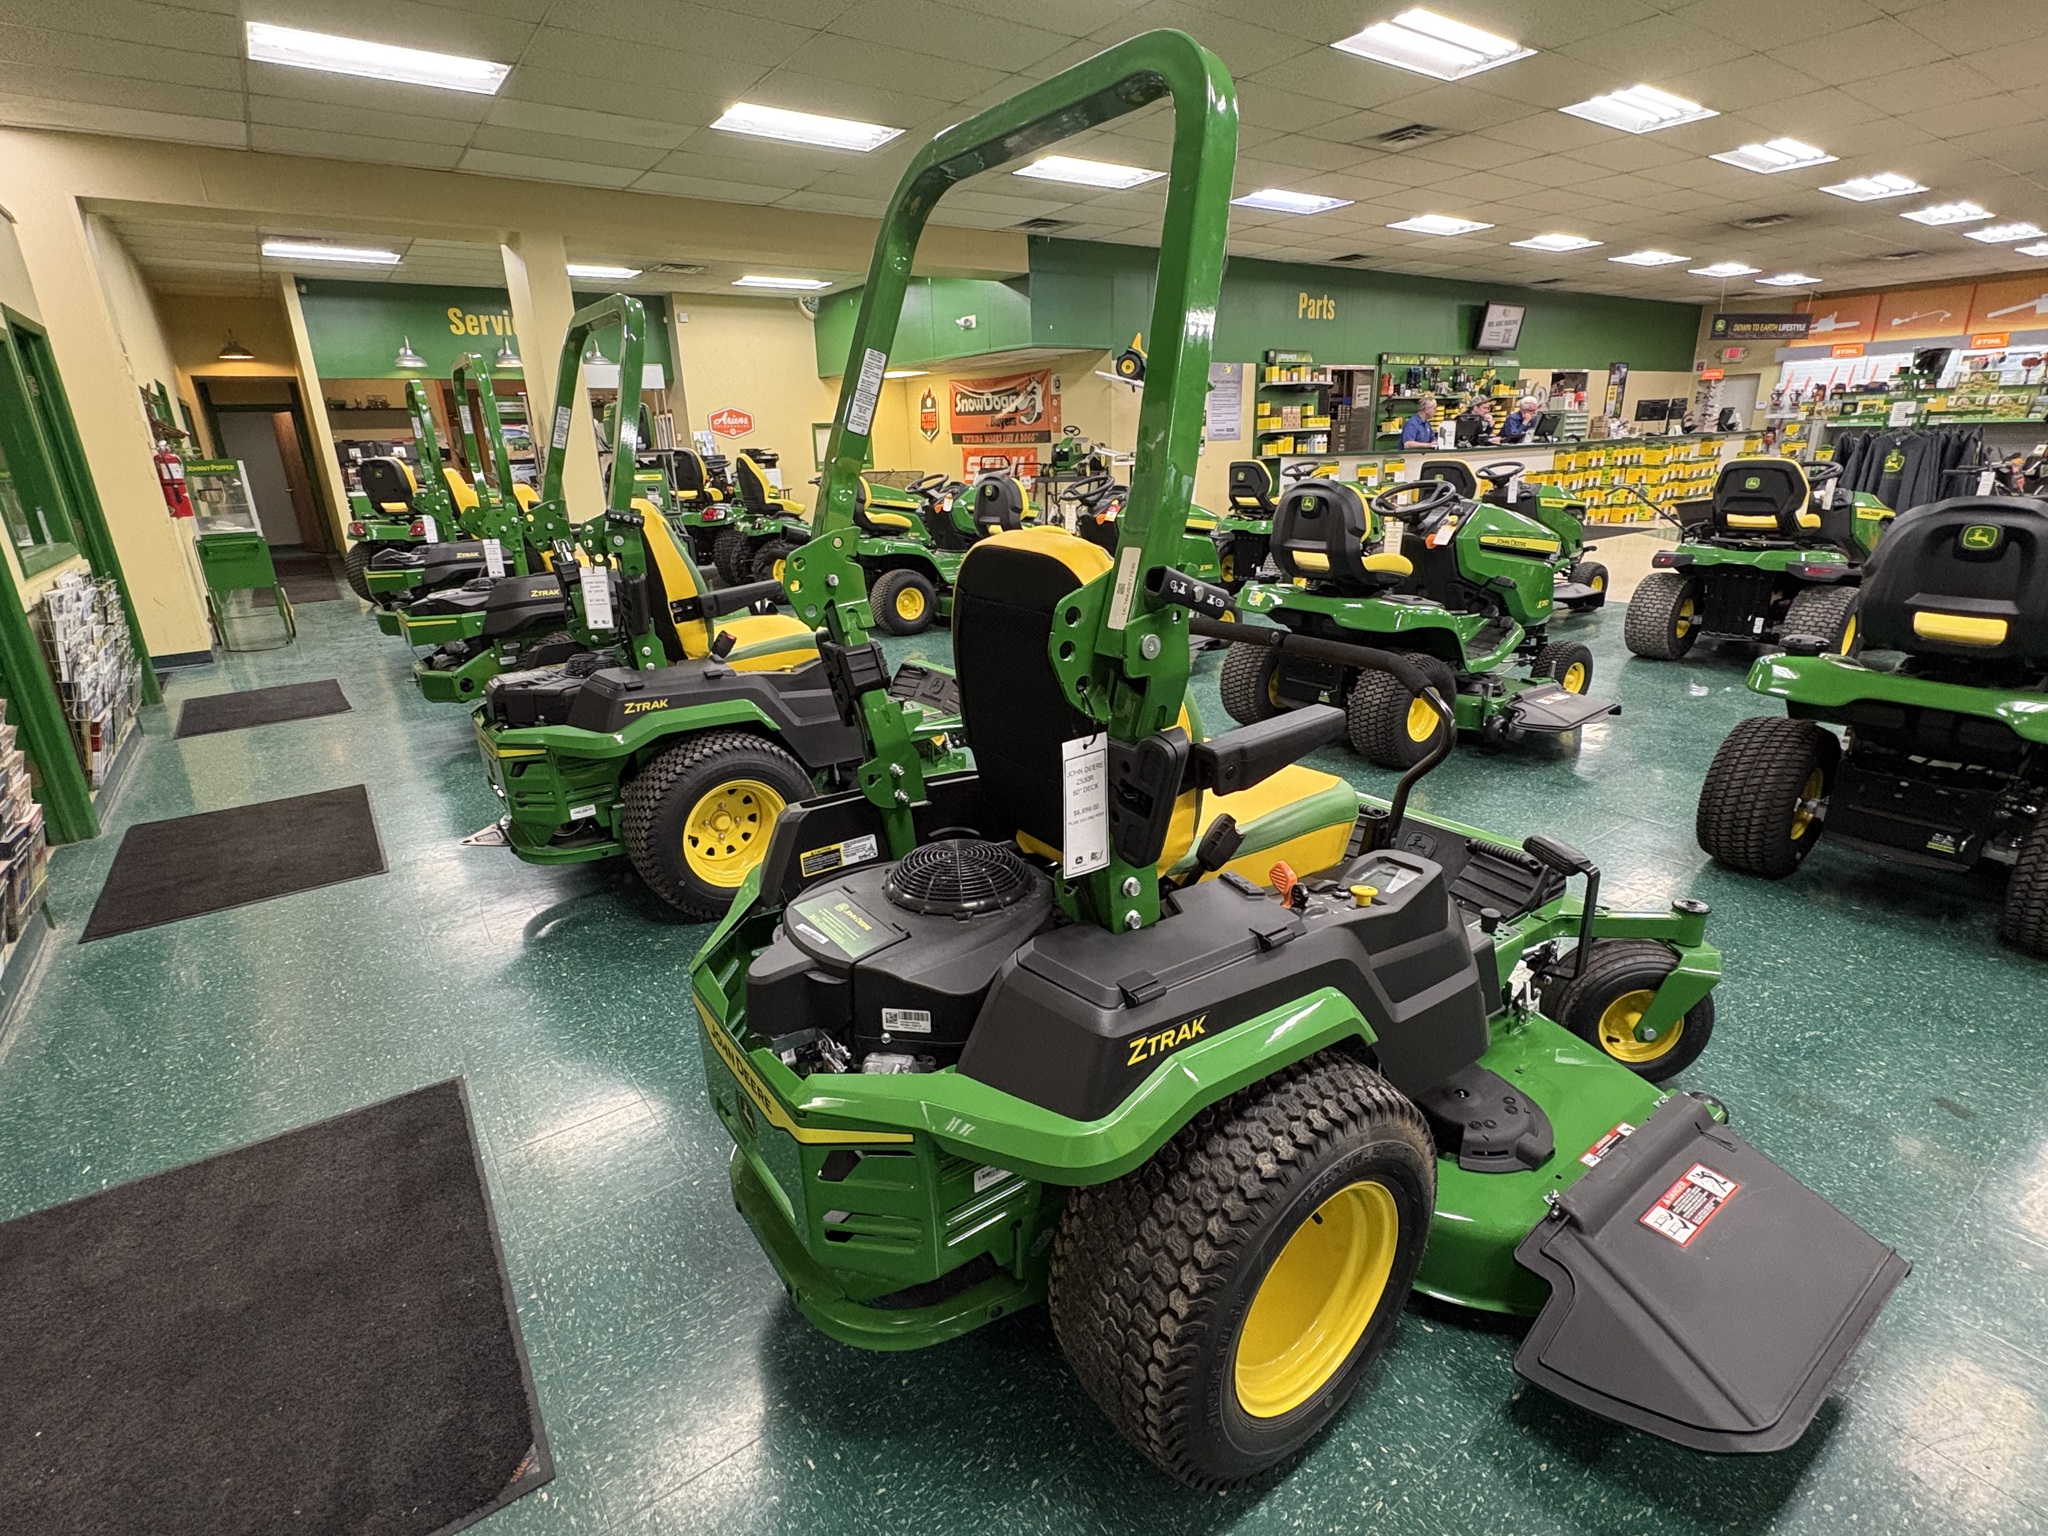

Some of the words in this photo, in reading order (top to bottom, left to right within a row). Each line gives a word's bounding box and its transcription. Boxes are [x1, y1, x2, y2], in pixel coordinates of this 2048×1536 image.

[1299, 292, 1336, 320] Parts
[447, 307, 514, 336] Servi
[1733, 323, 1751, 332] DOWN
[1752, 323, 1760, 332] TO
[1760, 323, 1778, 332] EARTH
[1778, 323, 1807, 332] LIFESTYLE
[1975, 337, 2003, 346] STIHL
[713, 411, 749, 425] Ariens
[1511, 539, 1527, 547] DEERE
[455, 551, 480, 559] ZTRAK
[530, 588, 560, 598] ZTRAK
[623, 698, 669, 715] ZTRAK
[1067, 769, 1083, 778] JOHN
[1084, 762, 1103, 773] DEERE
[1083, 782, 1100, 793] DECK
[1127, 1014, 1207, 1067] ZTRAK
[711, 1023, 736, 1066] JOHN
[736, 1056, 773, 1115] DEERE
